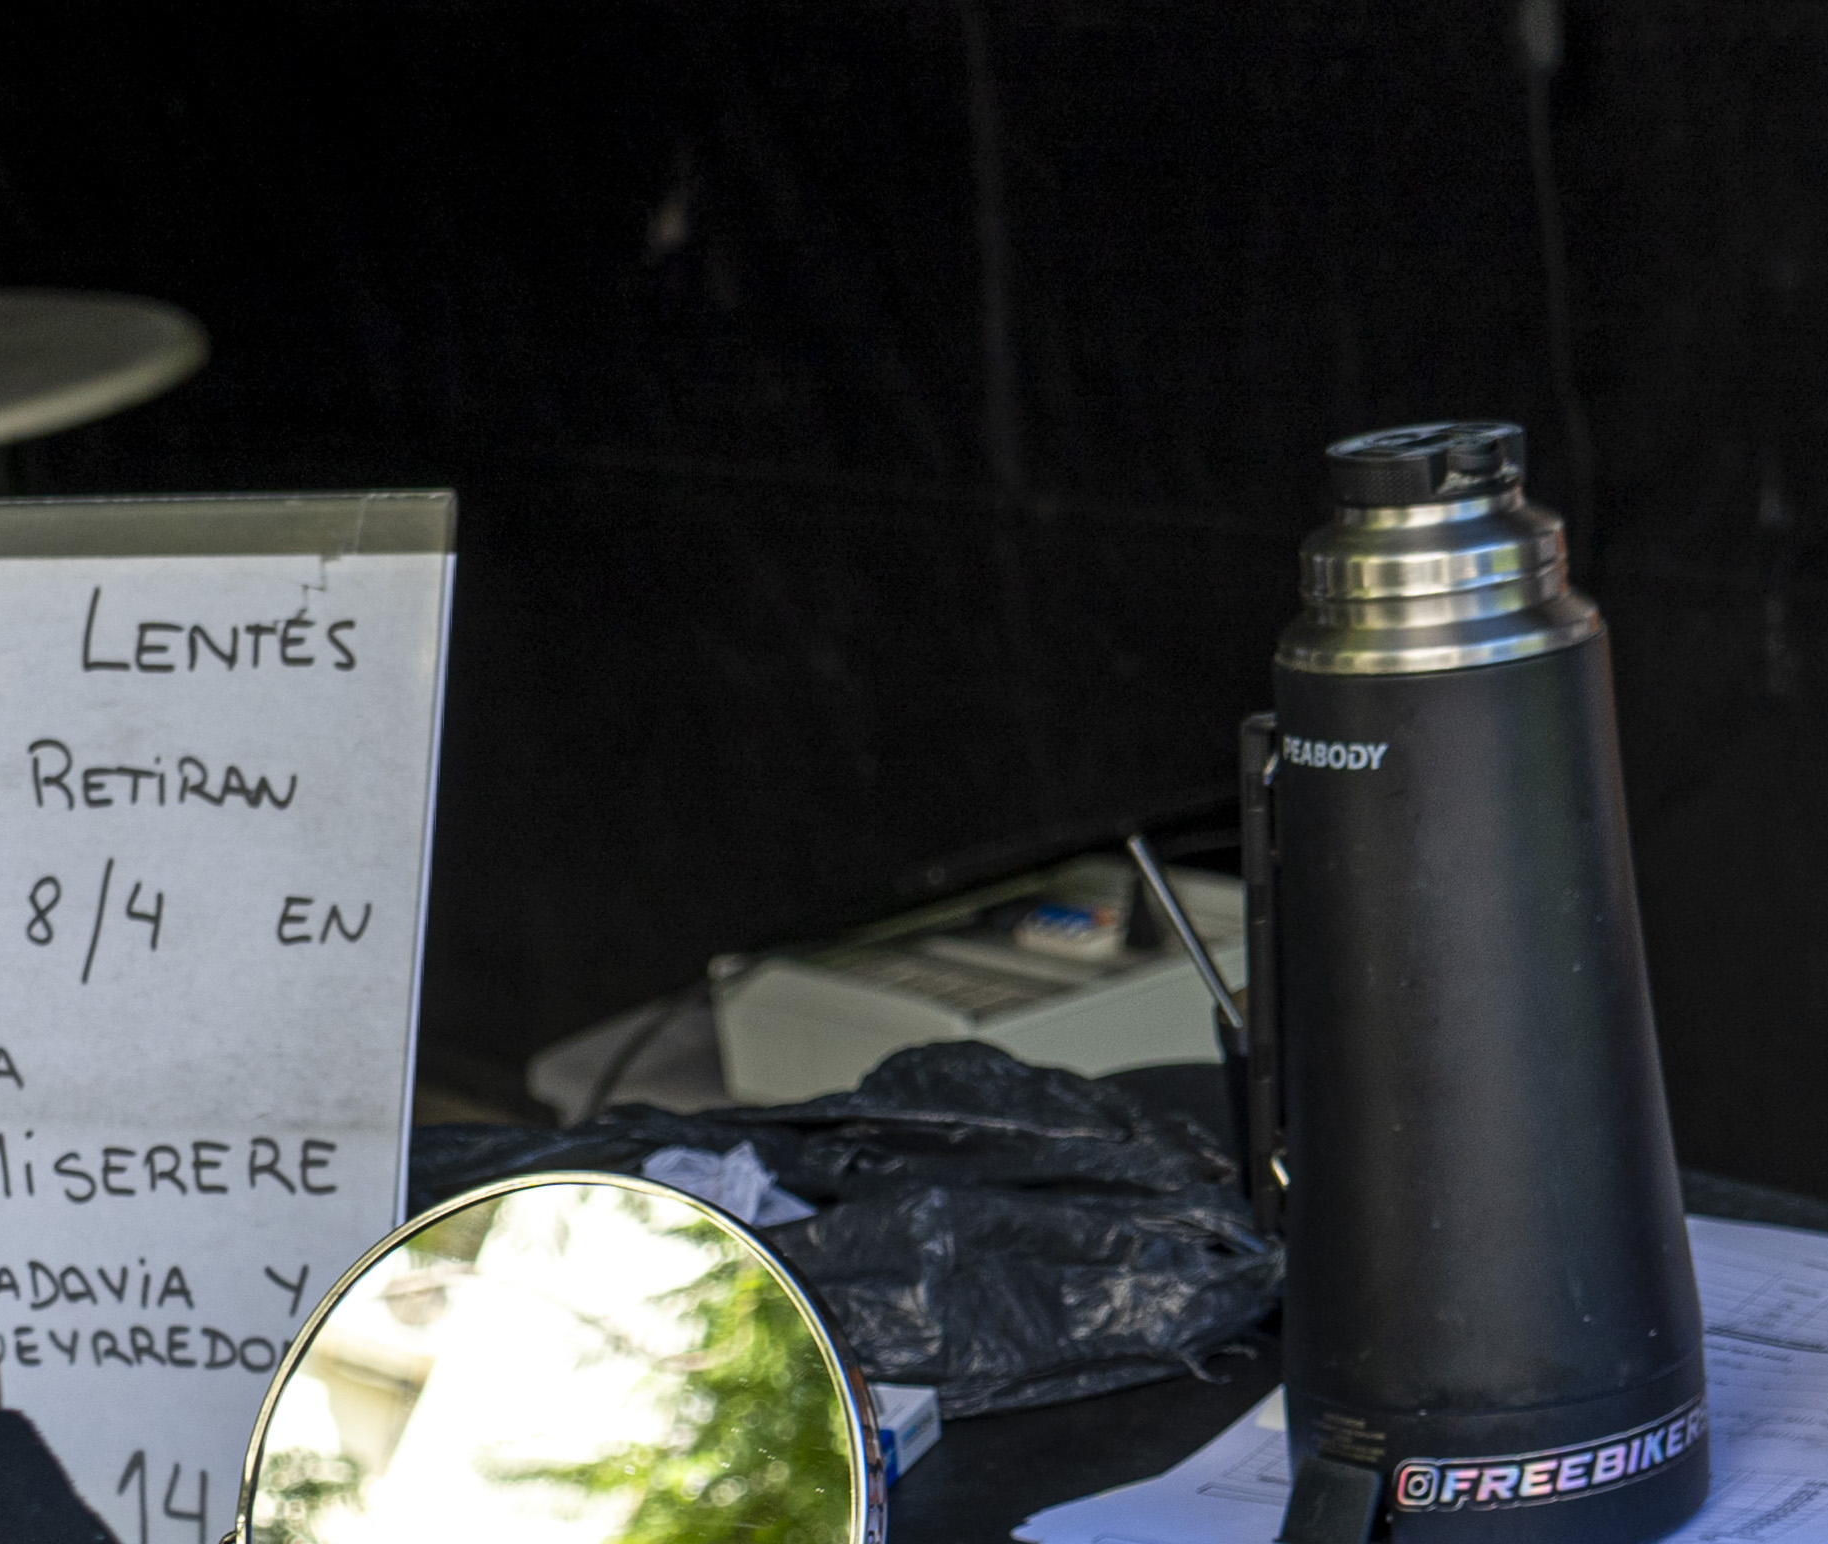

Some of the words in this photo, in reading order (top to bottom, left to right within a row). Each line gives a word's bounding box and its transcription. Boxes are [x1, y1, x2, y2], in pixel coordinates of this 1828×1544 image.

[1282, 736, 1389, 770] PEABODY
[24, 857, 165, 985] 8/4
[276, 896, 372, 946] EN
[264, 1263, 310, 1318] Y
[1439, 1405, 1707, 1504] FREEBIKER
